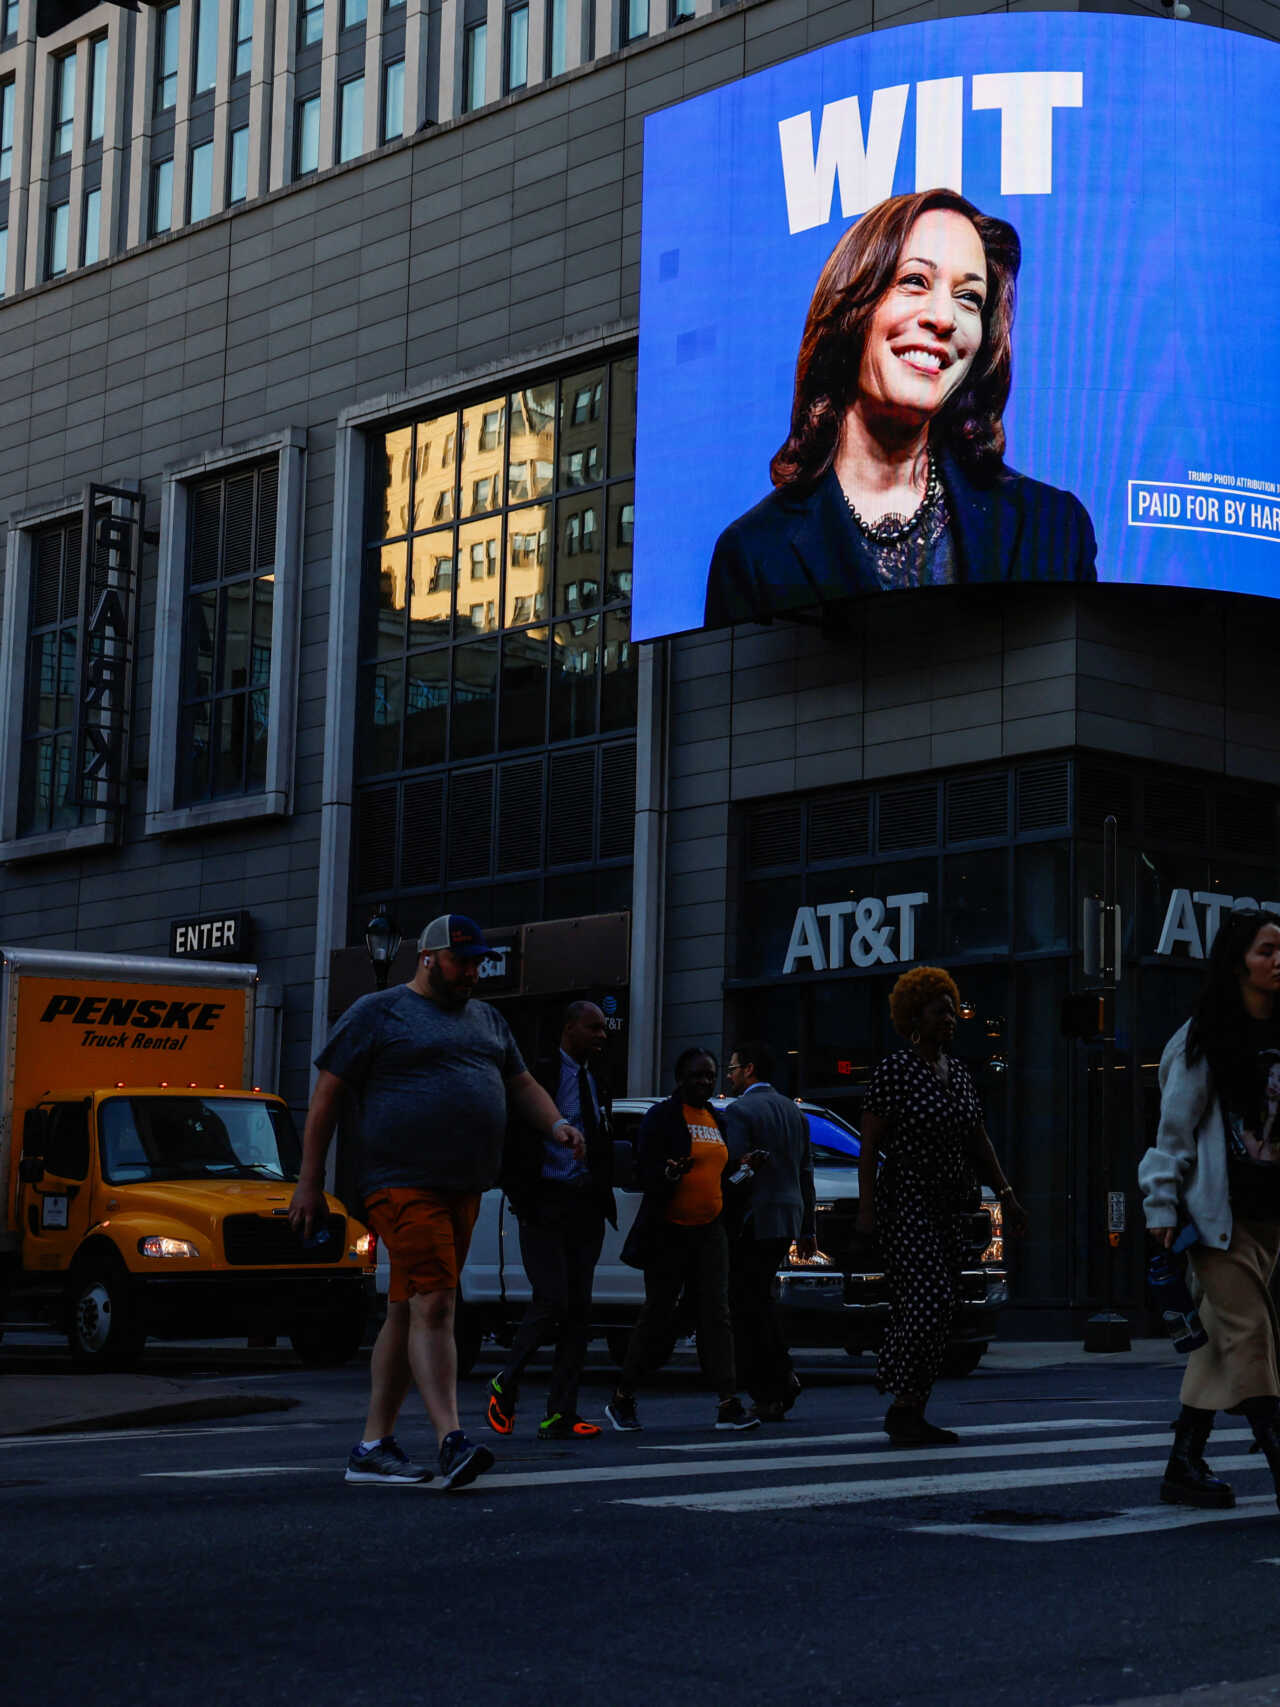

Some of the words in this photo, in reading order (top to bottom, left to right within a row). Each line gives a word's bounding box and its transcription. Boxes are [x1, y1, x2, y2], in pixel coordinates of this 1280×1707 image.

[778, 71, 1083, 235] WIT
[1188, 470, 1213, 483] TRUMP
[1214, 472, 1236, 486] PHOTO
[1236, 476, 1275, 493] ATTRIBUTION
[1138, 491, 1180, 519] PAID
[1187, 495, 1219, 523] FOR
[1224, 499, 1247, 526] BY
[175, 920, 235, 953] ENTER
[783, 891, 928, 975] AT&T
[40, 995, 225, 1030] PENSKE
[81, 1030, 129, 1048] Truck
[131, 1032, 188, 1050] Rental
